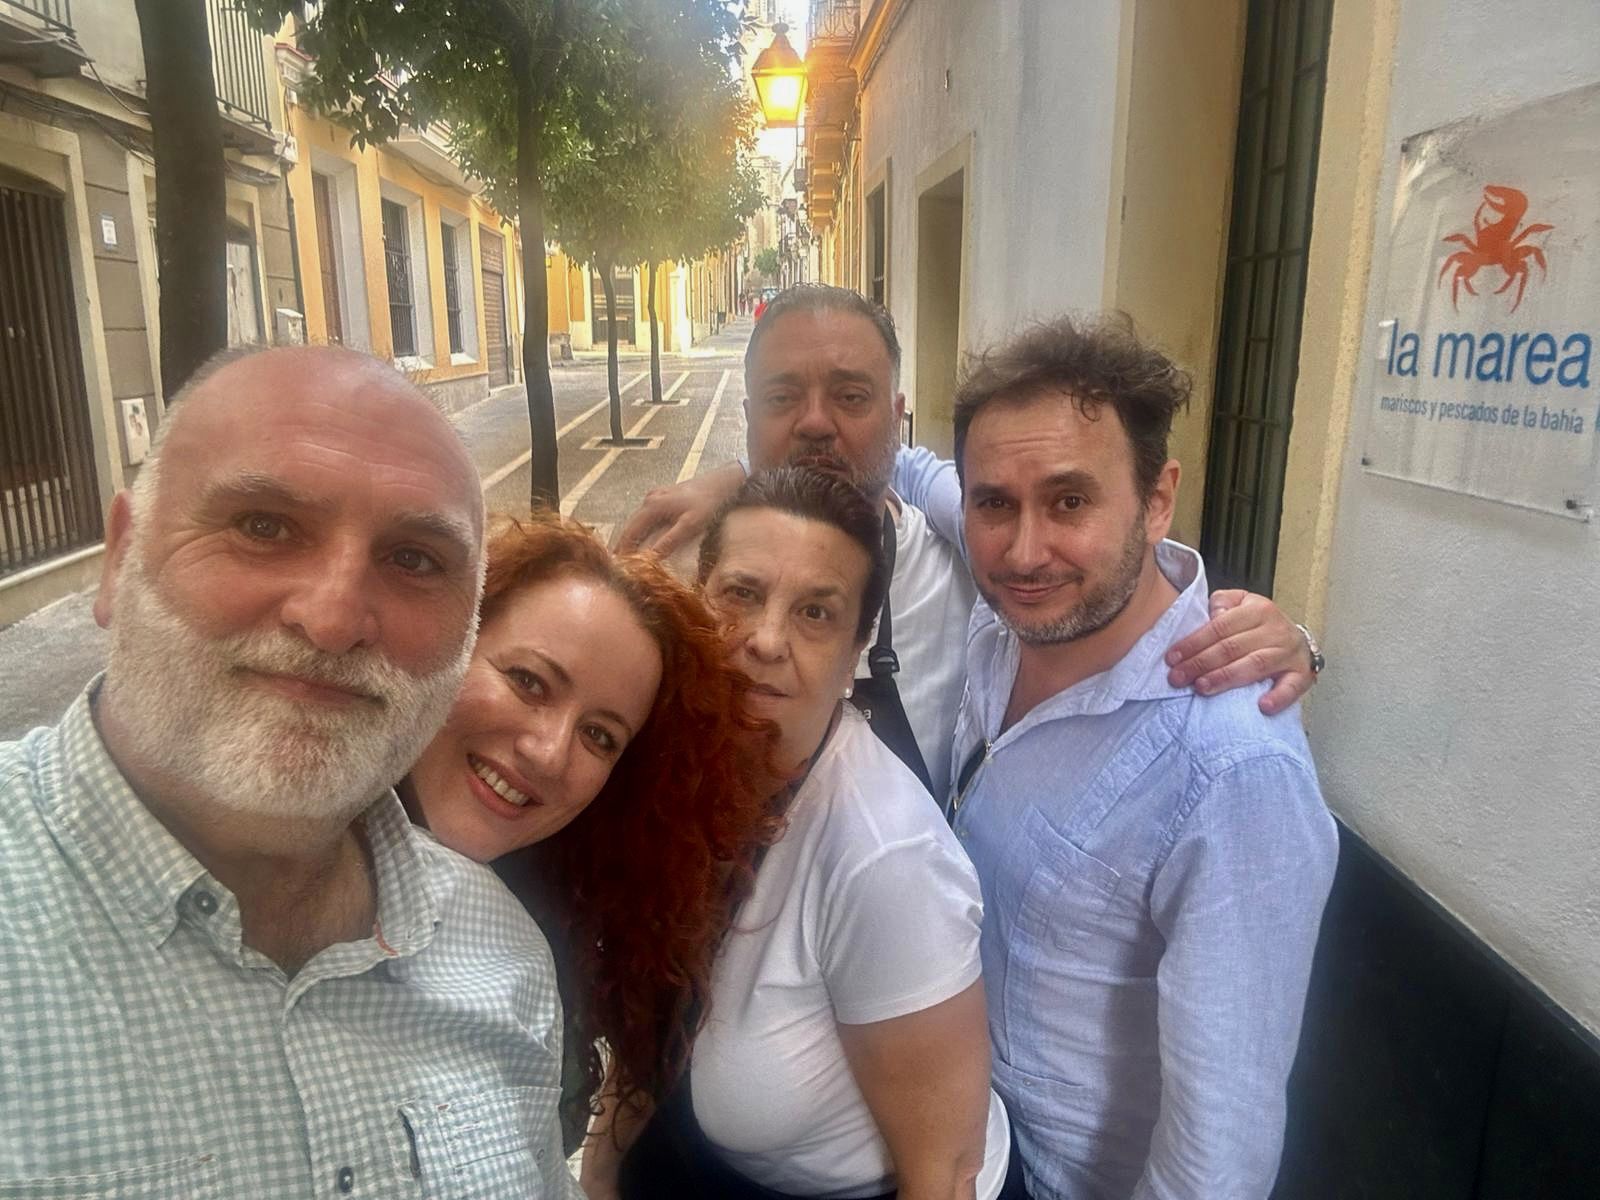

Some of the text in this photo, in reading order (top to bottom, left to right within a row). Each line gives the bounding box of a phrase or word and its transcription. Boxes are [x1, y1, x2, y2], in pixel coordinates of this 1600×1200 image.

[1387, 318, 1592, 388] la marea
[1381, 394, 1584, 433] mariscos y pescados de la bahía
